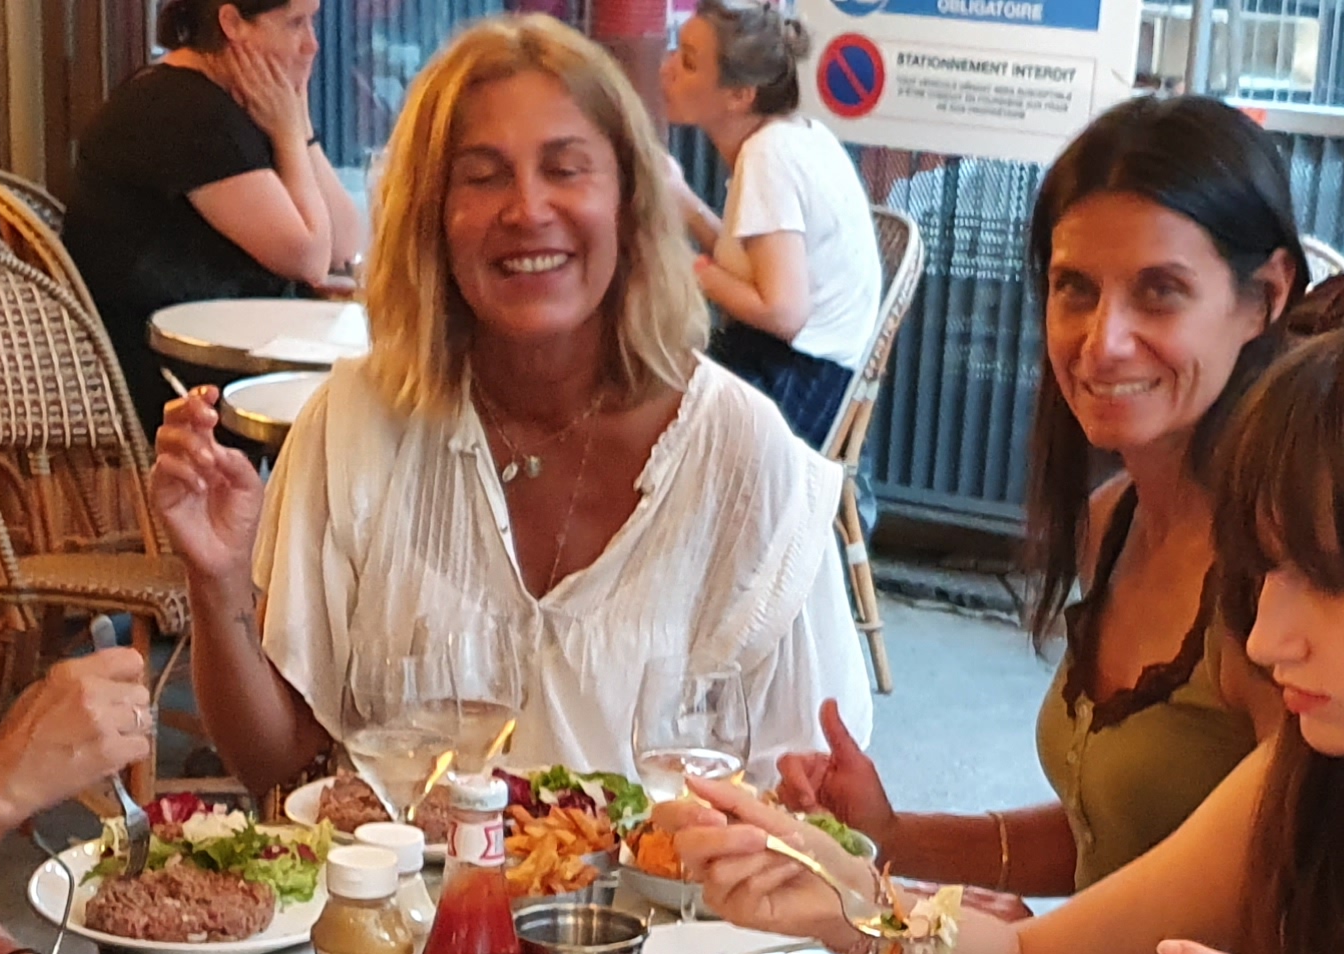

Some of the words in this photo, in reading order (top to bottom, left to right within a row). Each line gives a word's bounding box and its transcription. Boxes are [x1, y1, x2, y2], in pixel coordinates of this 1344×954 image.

[937, 0, 1044, 21] OBLIGATOIRE
[897, 52, 1009, 76] STATIONNEMENT
[1011, 63, 1077, 83] INTERDIT
